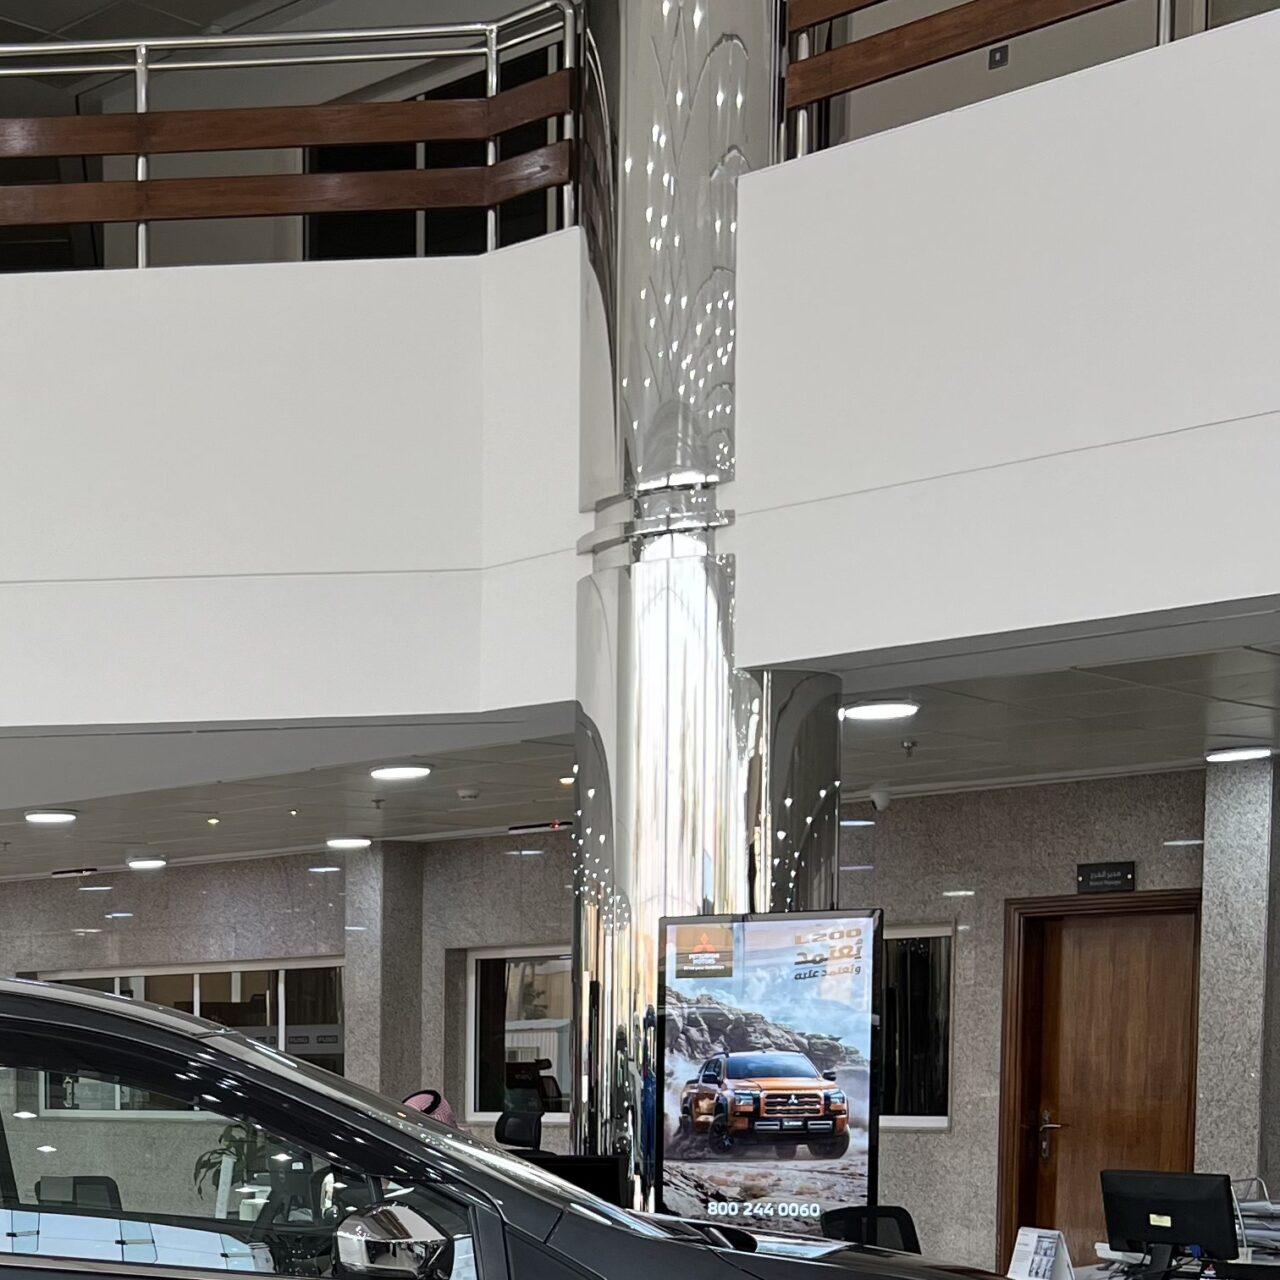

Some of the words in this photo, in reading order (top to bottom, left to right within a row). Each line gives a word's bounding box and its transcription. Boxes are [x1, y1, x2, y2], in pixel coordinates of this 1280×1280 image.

[795, 928, 862, 944] L200
[708, 1201, 739, 1215] 800
[743, 1202, 774, 1216] 244
[778, 1203, 820, 1217] 0060
